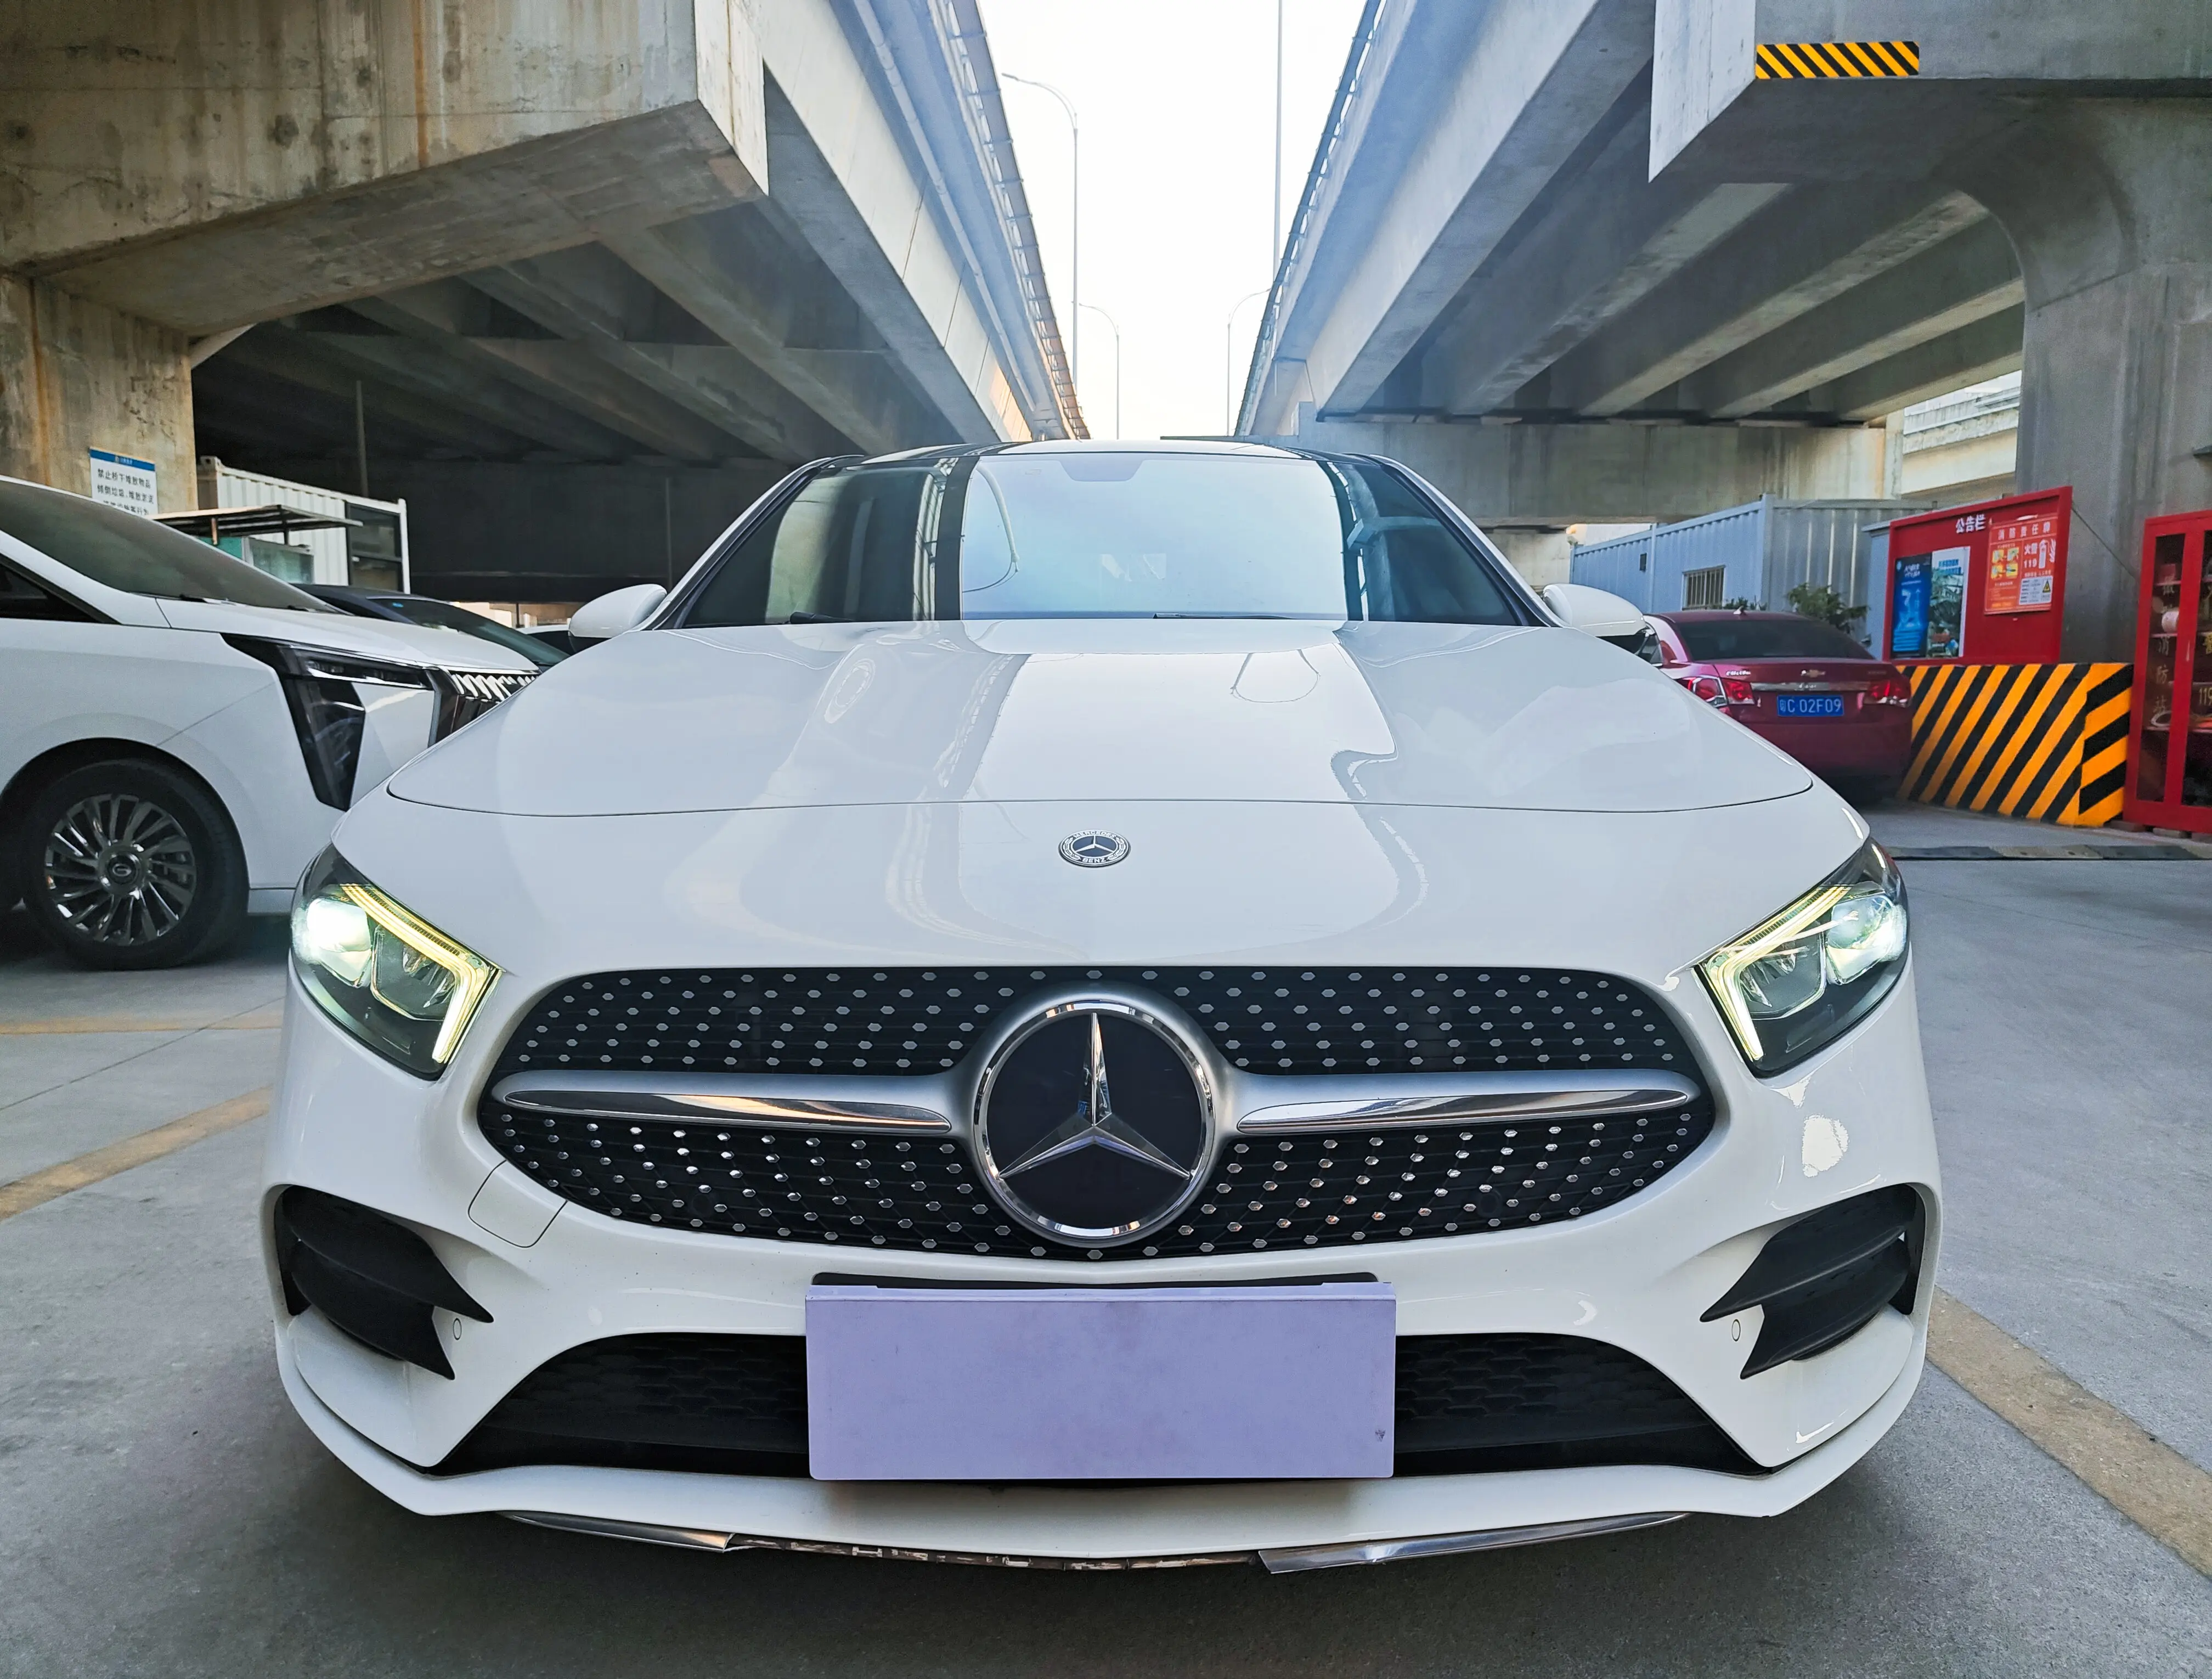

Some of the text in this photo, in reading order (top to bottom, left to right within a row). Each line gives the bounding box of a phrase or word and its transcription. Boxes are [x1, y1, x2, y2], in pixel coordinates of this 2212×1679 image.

[1956, 514, 1985, 533] 公告栏
[2024, 559, 2037, 568] 119
